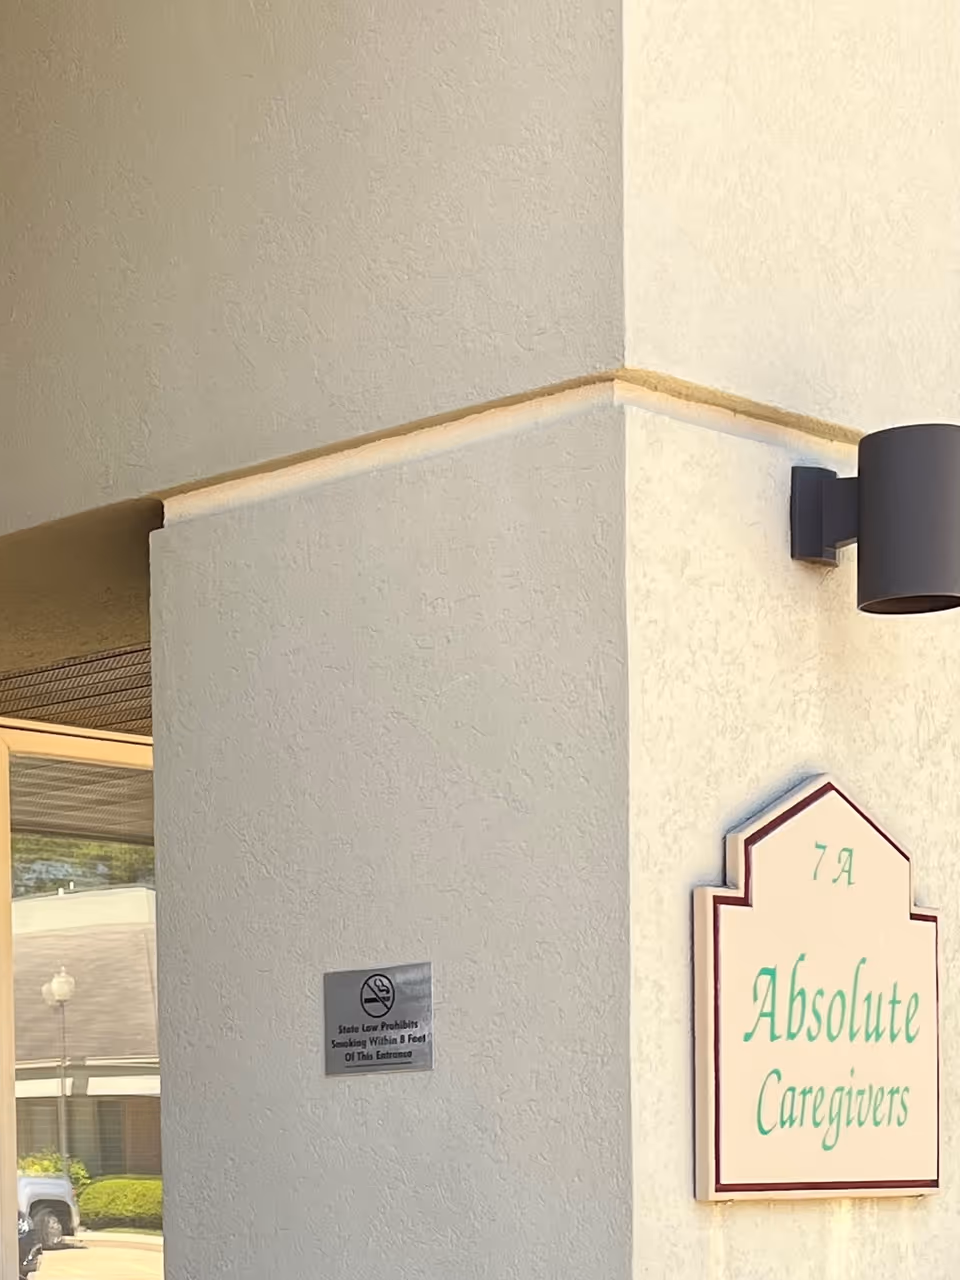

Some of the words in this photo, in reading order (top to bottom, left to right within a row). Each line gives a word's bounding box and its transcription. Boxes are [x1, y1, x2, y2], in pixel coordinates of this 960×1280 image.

[742, 952, 921, 1045] Absolute
[338, 1024, 359, 1035] State
[362, 1023, 378, 1033] Law
[380, 1020, 418, 1031] Prohibits
[331, 1038, 367, 1049] Smoking
[369, 1035, 397, 1046] Within
[407, 1033, 426, 1043] Feet
[344, 1052, 355, 1062] Of
[357, 1050, 373, 1061] This
[376, 1050, 412, 1060] Entrance
[755, 1067, 910, 1152] Caregivers
